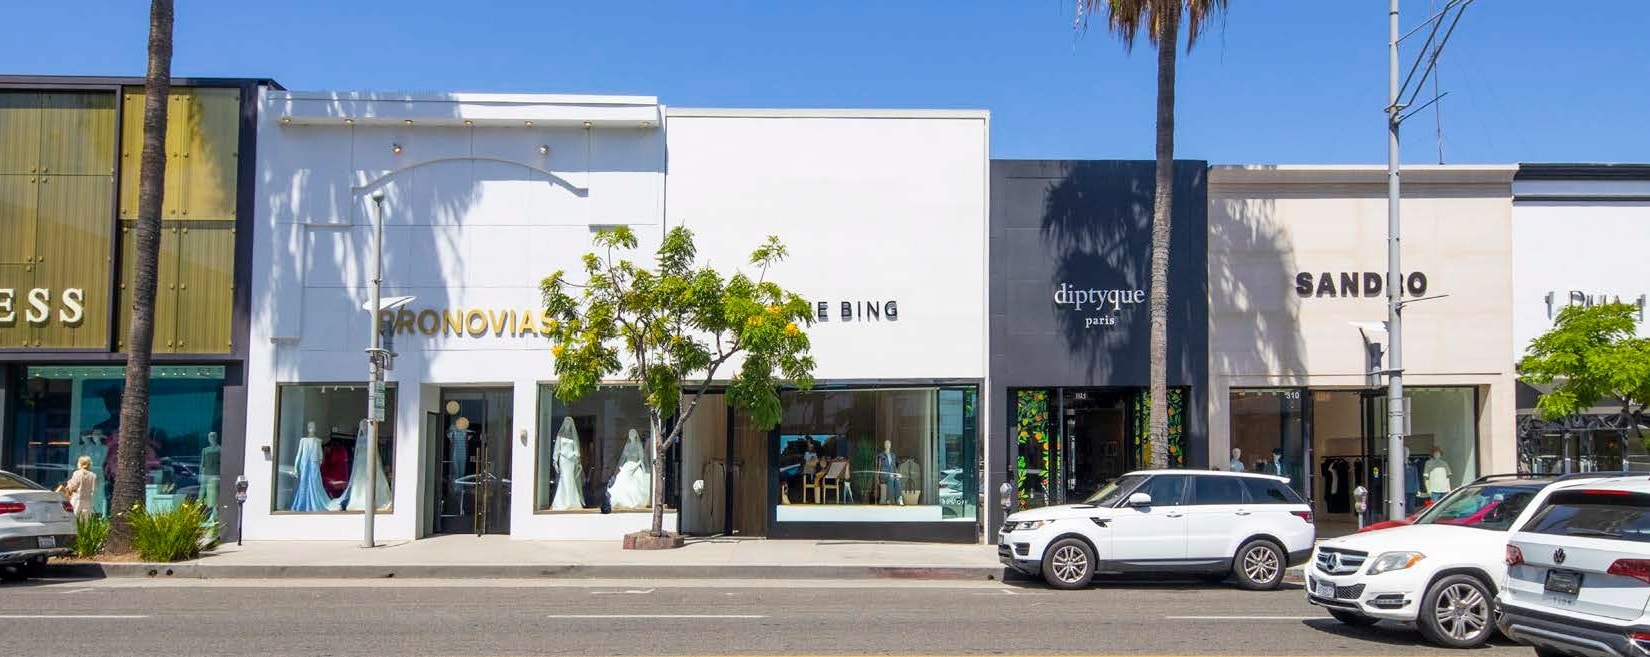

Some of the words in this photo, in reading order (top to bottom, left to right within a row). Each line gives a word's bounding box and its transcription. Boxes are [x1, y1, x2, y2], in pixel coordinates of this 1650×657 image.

[0, 287, 83, 323] ESS
[1054, 283, 1145, 311] diptyque
[840, 300, 898, 321] BING
[1085, 315, 1115, 328] paris
